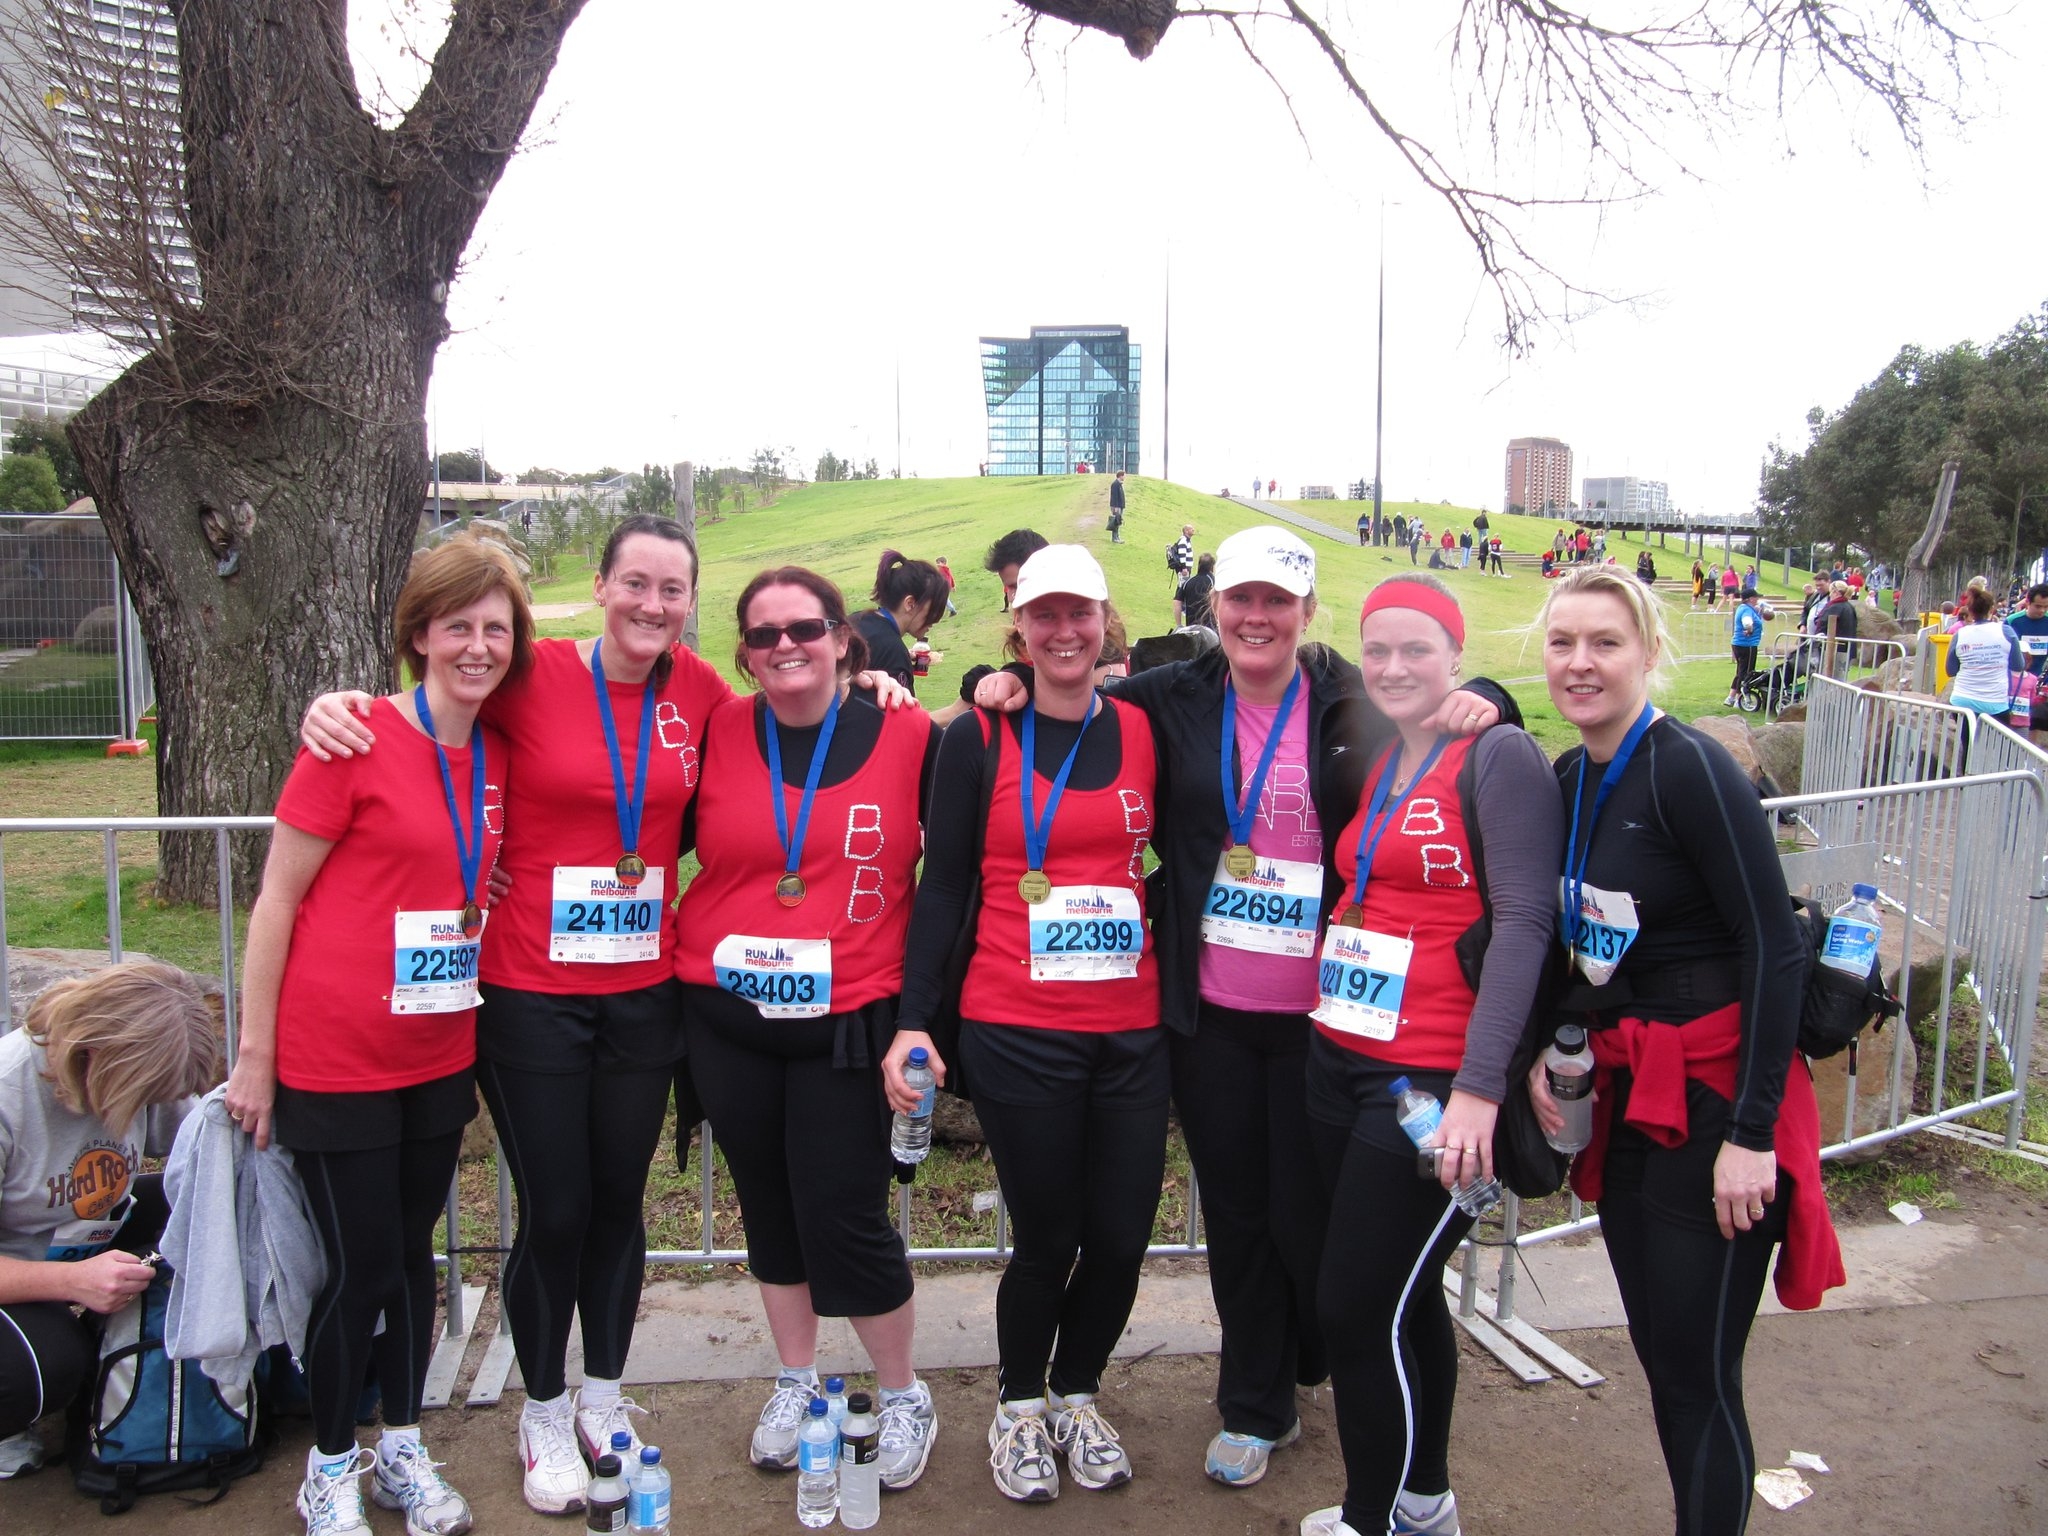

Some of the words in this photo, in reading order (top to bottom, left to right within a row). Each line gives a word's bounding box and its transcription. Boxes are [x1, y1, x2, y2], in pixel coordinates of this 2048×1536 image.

[656, 700, 690, 748] B
[1118, 789, 1151, 833] B
[1400, 798, 1445, 836] B
[845, 804, 885, 860] B
[590, 880, 616, 889] RUN
[590, 888, 638, 896] melbourne
[848, 865, 886, 923] B
[1065, 899, 1090, 908] RUN
[1065, 906, 1113, 915] melbourne
[1211, 887, 1304, 927] 22694
[430, 924, 455, 934] RUN
[567, 902, 652, 933] 24140
[430, 932, 467, 942] melbour
[1046, 921, 1133, 952] 22399
[1579, 921, 1628, 960] 2137
[575, 952, 596, 960] 24140
[745, 948, 768, 959] RUN
[1285, 945, 1305, 955] 22694
[411, 947, 477, 982] 22597
[744, 957, 794, 968] melbourne
[727, 970, 816, 1004] 23403
[1322, 962, 1390, 1005] 22197
[416, 1002, 436, 1011] 22597
[1363, 1025, 1386, 1037] 22197
[93, 1139, 129, 1155] PLANET
[46, 1160, 97, 1209] Hard
[96, 1143, 139, 1190] Rock
